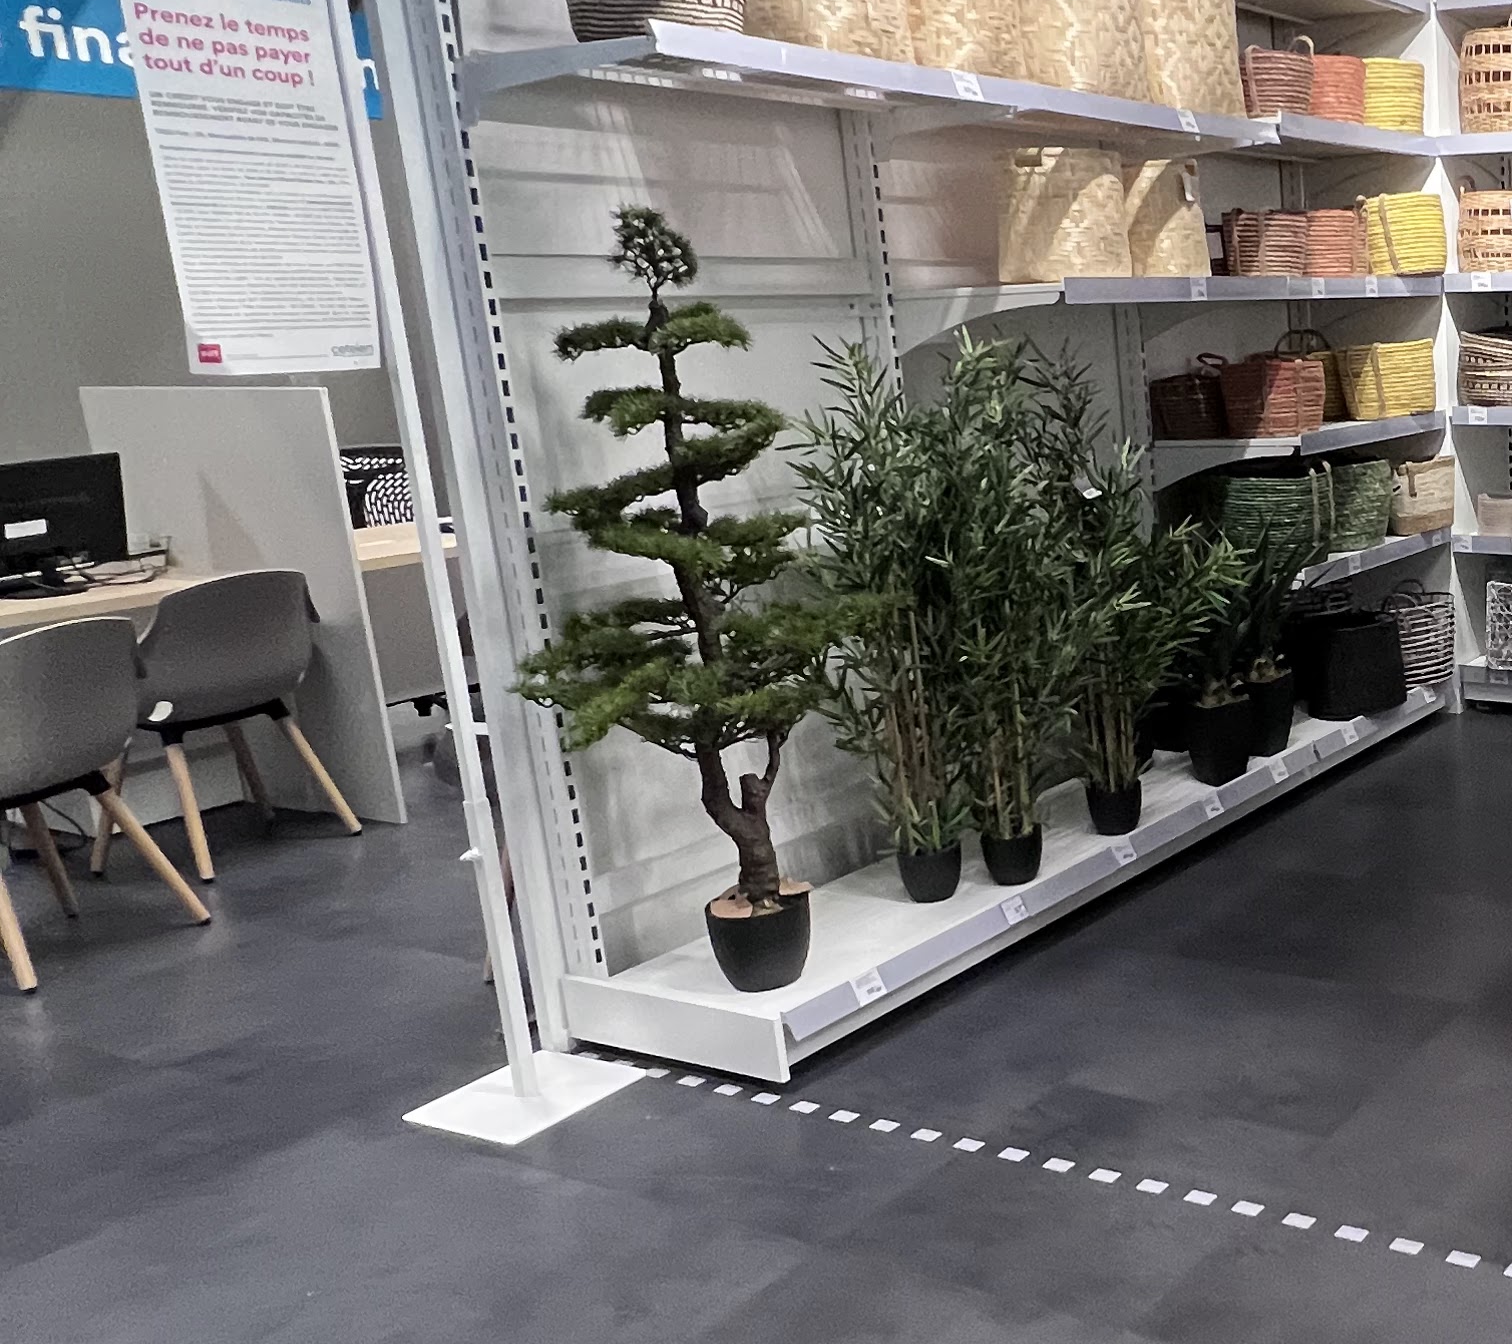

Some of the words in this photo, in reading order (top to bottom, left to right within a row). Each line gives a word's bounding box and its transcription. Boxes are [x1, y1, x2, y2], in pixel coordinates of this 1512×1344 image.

[133, 2, 215, 29] Prenez
[219, 12, 239, 32] le
[245, 18, 310, 43] temps
[138, 27, 169, 47] de
[177, 35, 204, 51] ne
[212, 40, 249, 57] pas
[255, 45, 311, 65] payer
[143, 53, 193, 73] tout
[199, 58, 246, 79] d'un
[252, 67, 304, 88] coup
